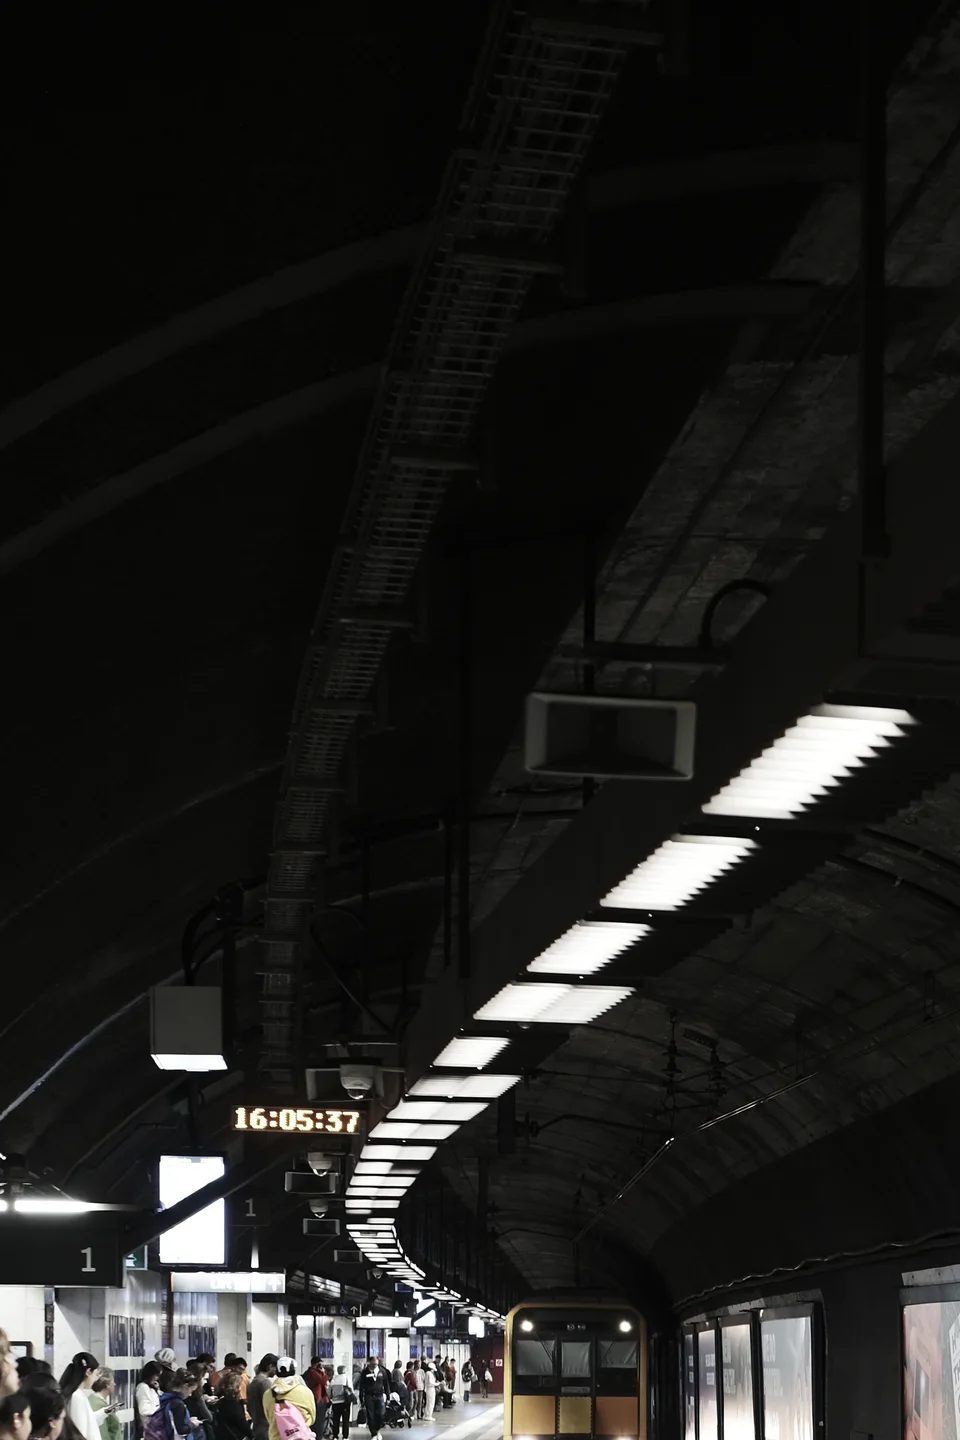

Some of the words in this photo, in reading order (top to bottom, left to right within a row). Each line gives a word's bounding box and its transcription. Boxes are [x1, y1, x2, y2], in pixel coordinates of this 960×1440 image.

[235, 1107, 360, 1133] 16:05:37
[245, 1198, 257, 1217] 1
[81, 1247, 96, 1272] 1
